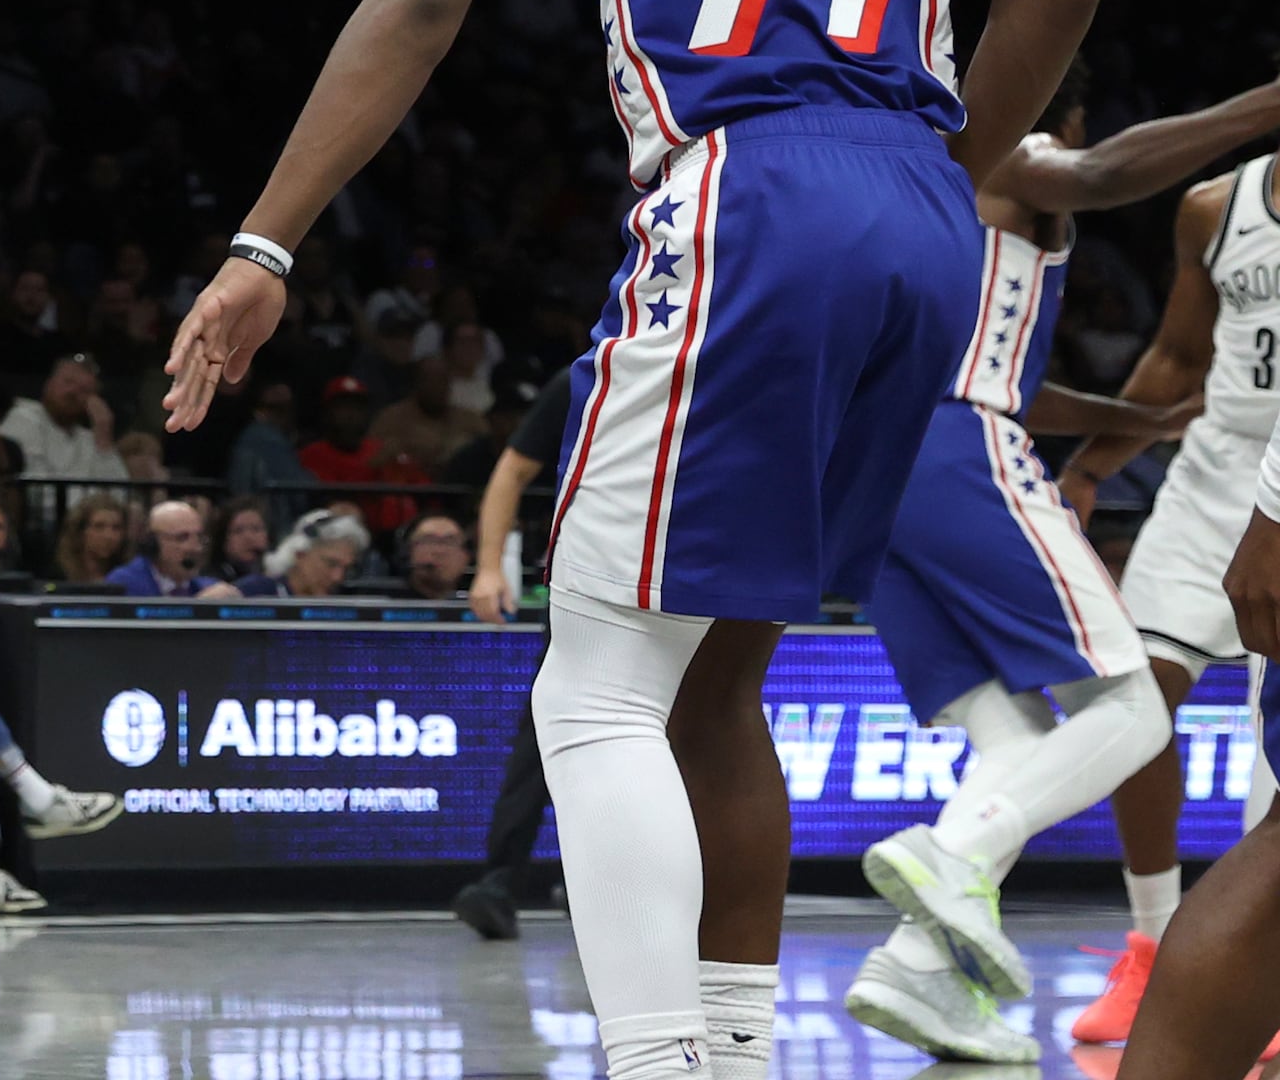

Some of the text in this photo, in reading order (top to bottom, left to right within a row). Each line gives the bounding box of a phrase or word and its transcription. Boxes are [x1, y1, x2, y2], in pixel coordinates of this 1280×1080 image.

[200, 698, 458, 758] Alibaba
[124, 788, 439, 814] OFFICIAL TECHNOLOGY PARTNER
